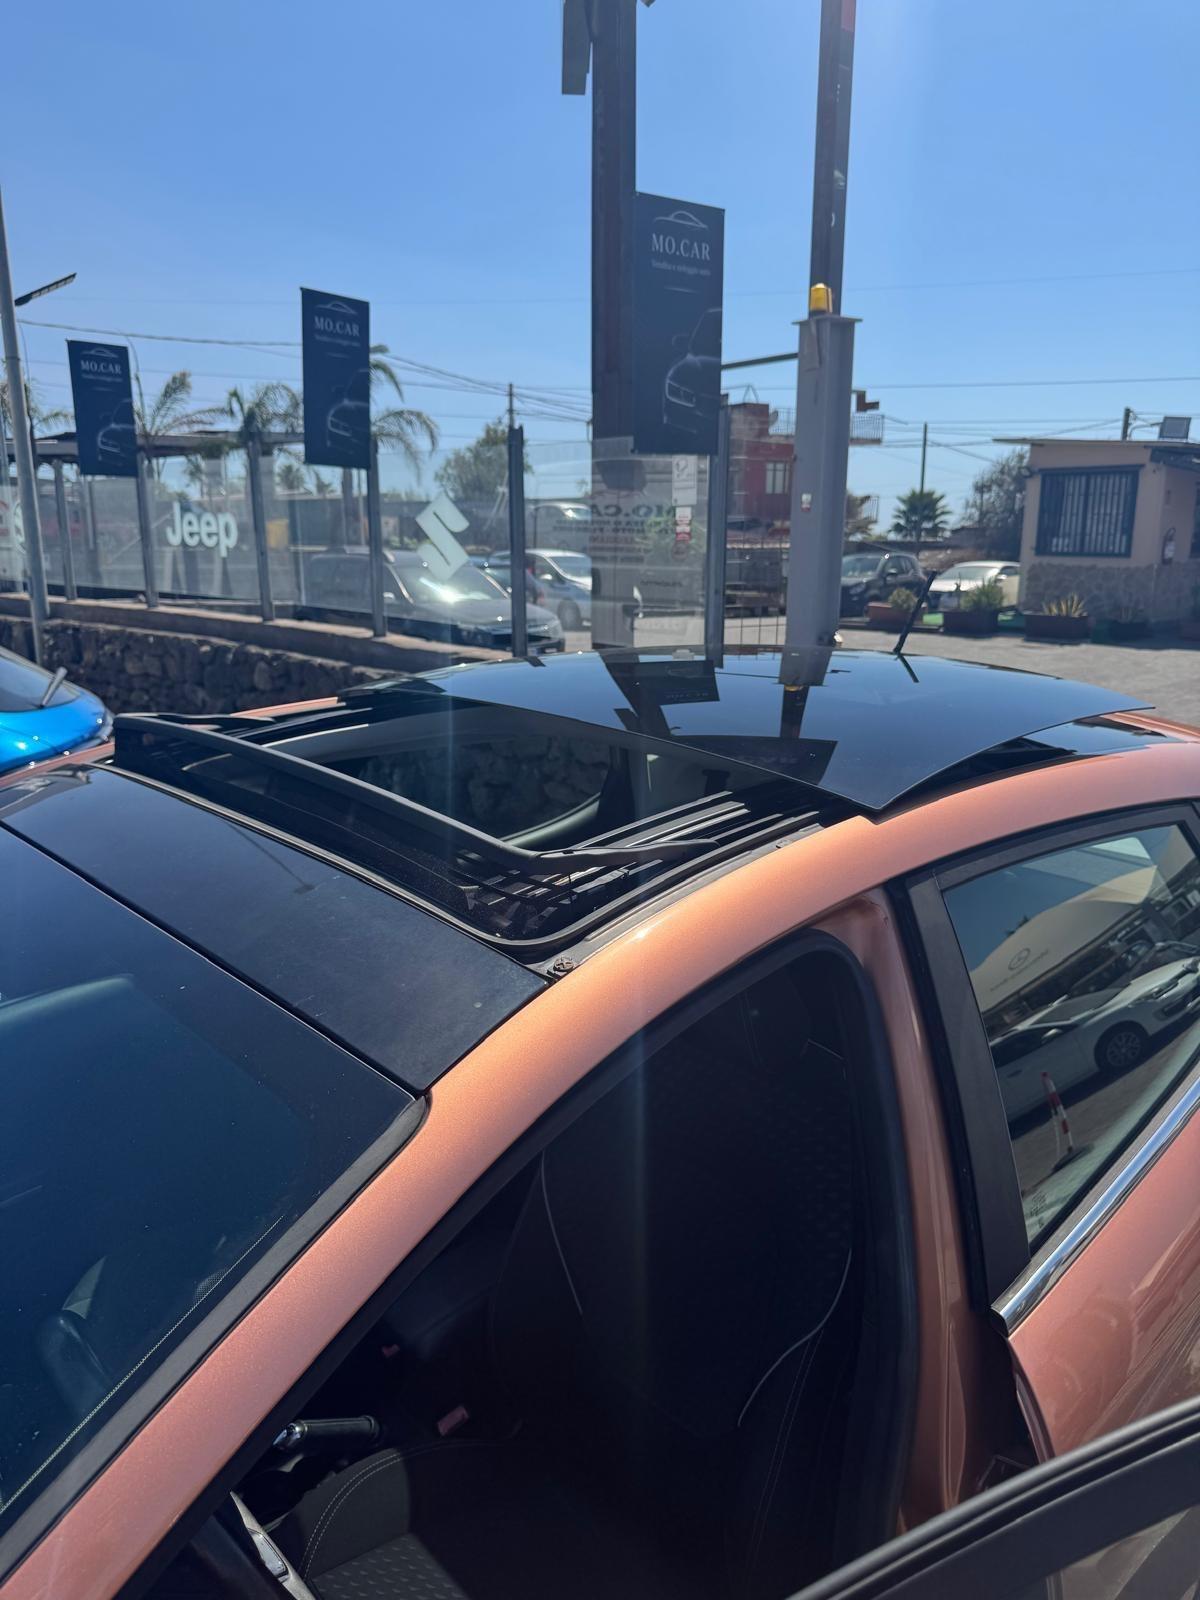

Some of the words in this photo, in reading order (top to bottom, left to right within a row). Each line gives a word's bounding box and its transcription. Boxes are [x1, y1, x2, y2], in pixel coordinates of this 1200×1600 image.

[651, 233, 711, 261] MO.CAR
[314, 315, 359, 336] MO.CAR
[81, 360, 122, 375] MO.CAR
[165, 501, 238, 557] Jeep
